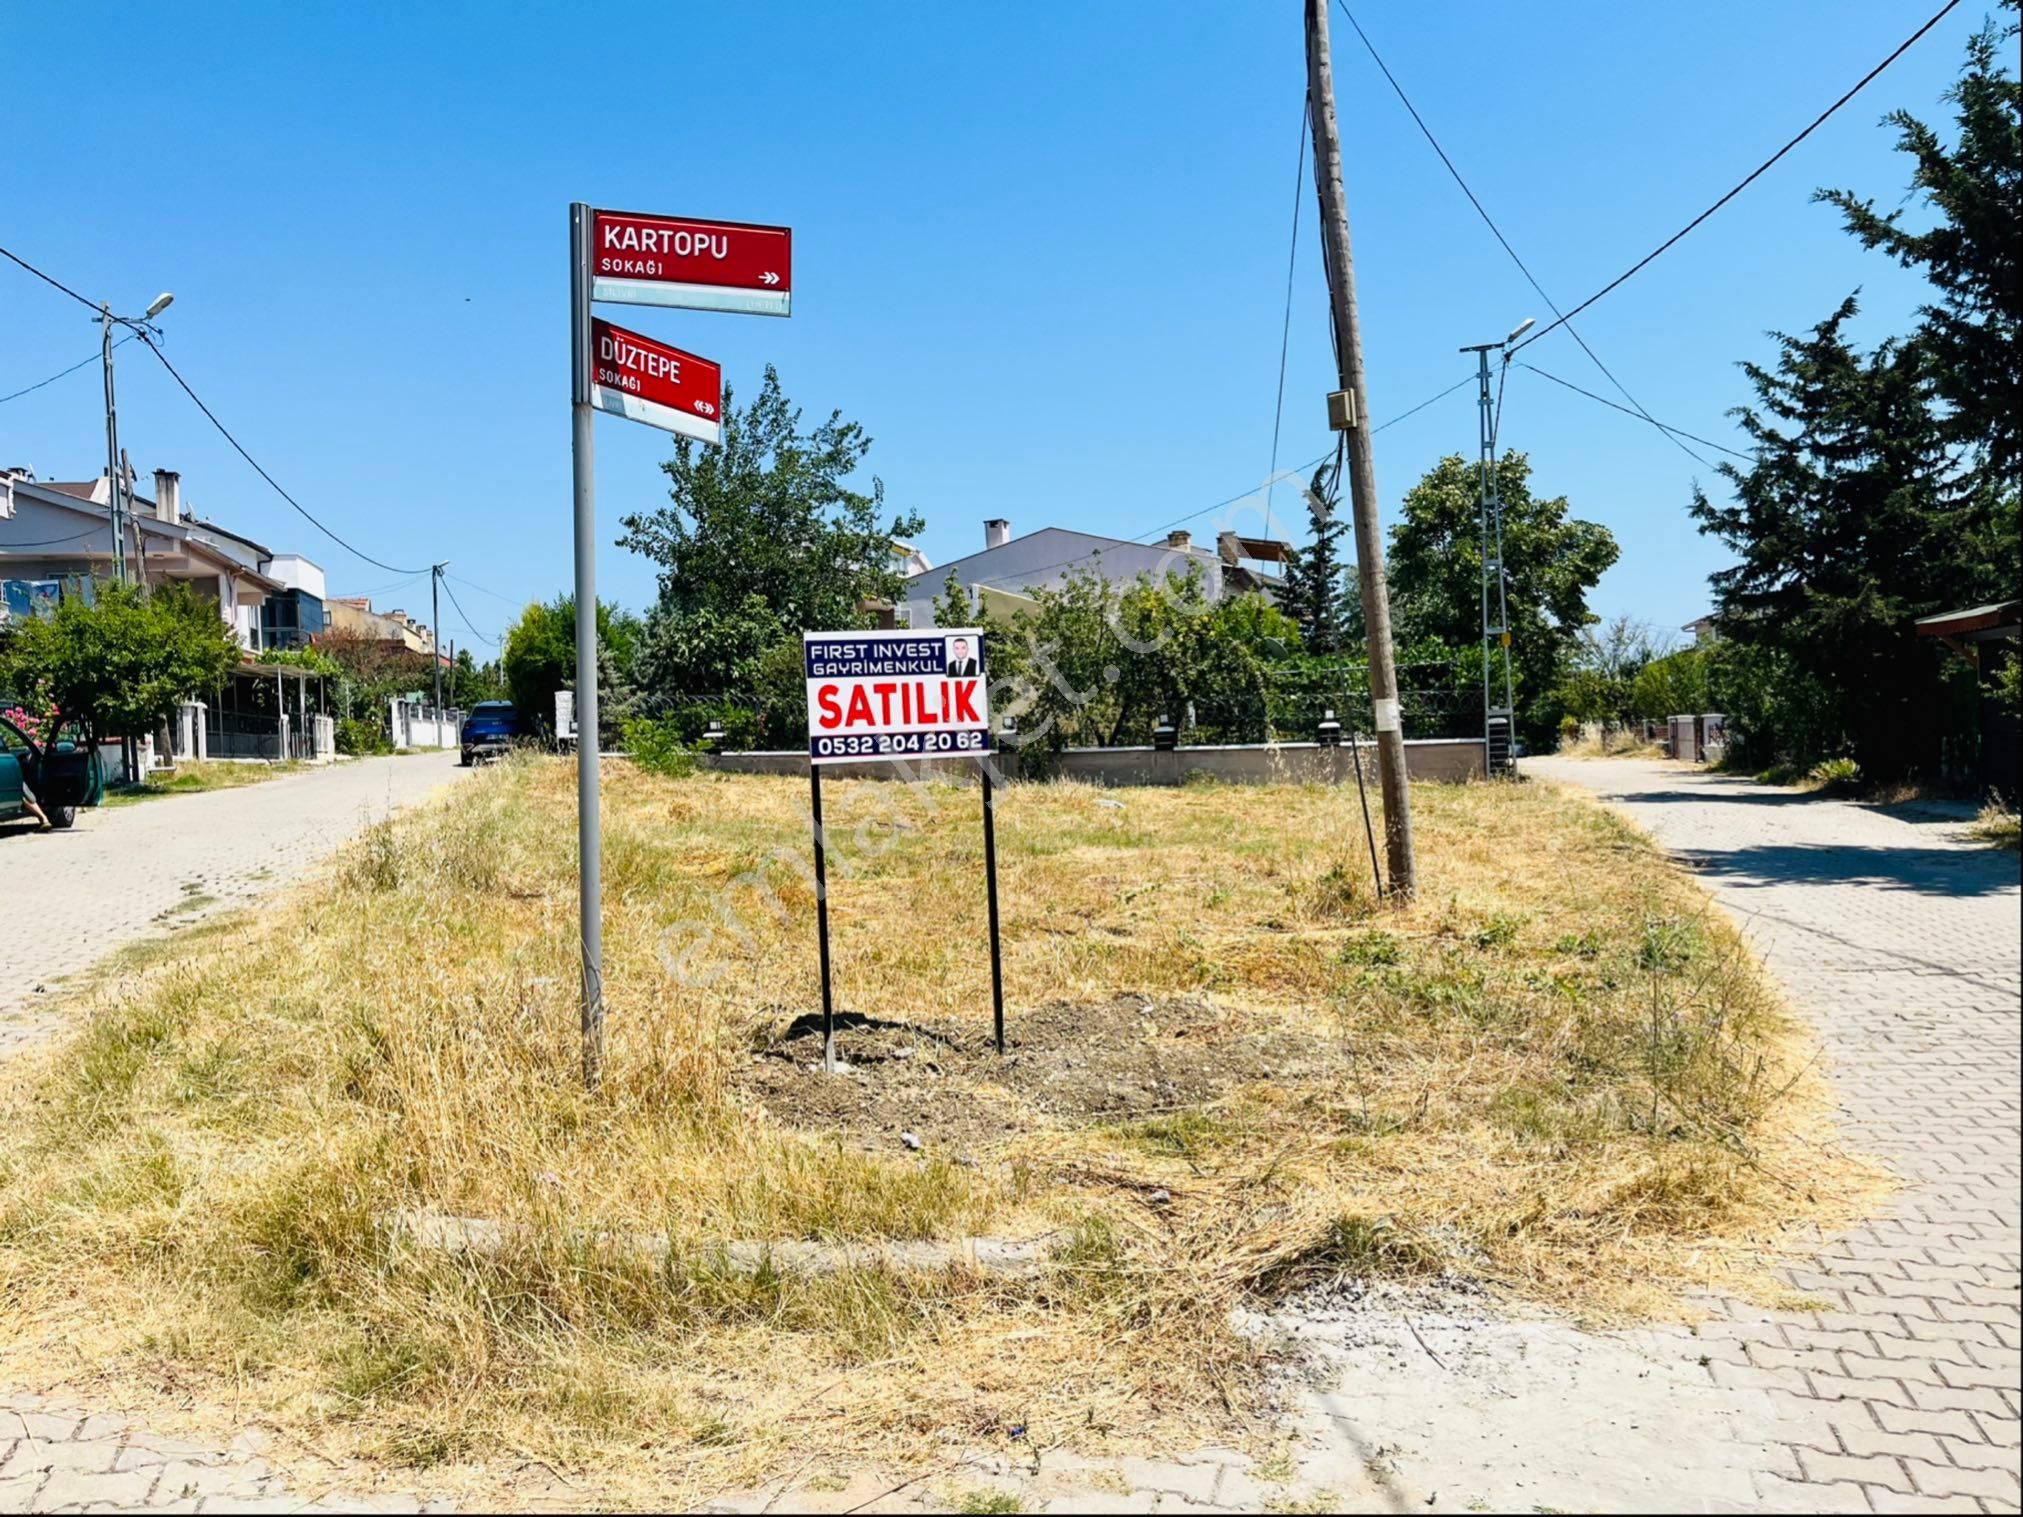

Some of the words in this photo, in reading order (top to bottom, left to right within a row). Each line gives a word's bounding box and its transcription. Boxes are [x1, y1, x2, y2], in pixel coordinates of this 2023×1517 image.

[604, 225, 728, 259] KARTOPU
[601, 258, 663, 275] SOKAĞI
[601, 336, 681, 384] DÜZTEPE
[599, 368, 641, 392] SOKAĞI
[811, 644, 868, 660] FIRST
[873, 642, 943, 658] INVEST
[813, 659, 943, 676] GAYRİMENKUL
[818, 680, 981, 729] SATILIK
[818, 736, 874, 755] 0532
[879, 734, 920, 753] 204
[924, 733, 951, 751] 20
[956, 731, 983, 749] 62
